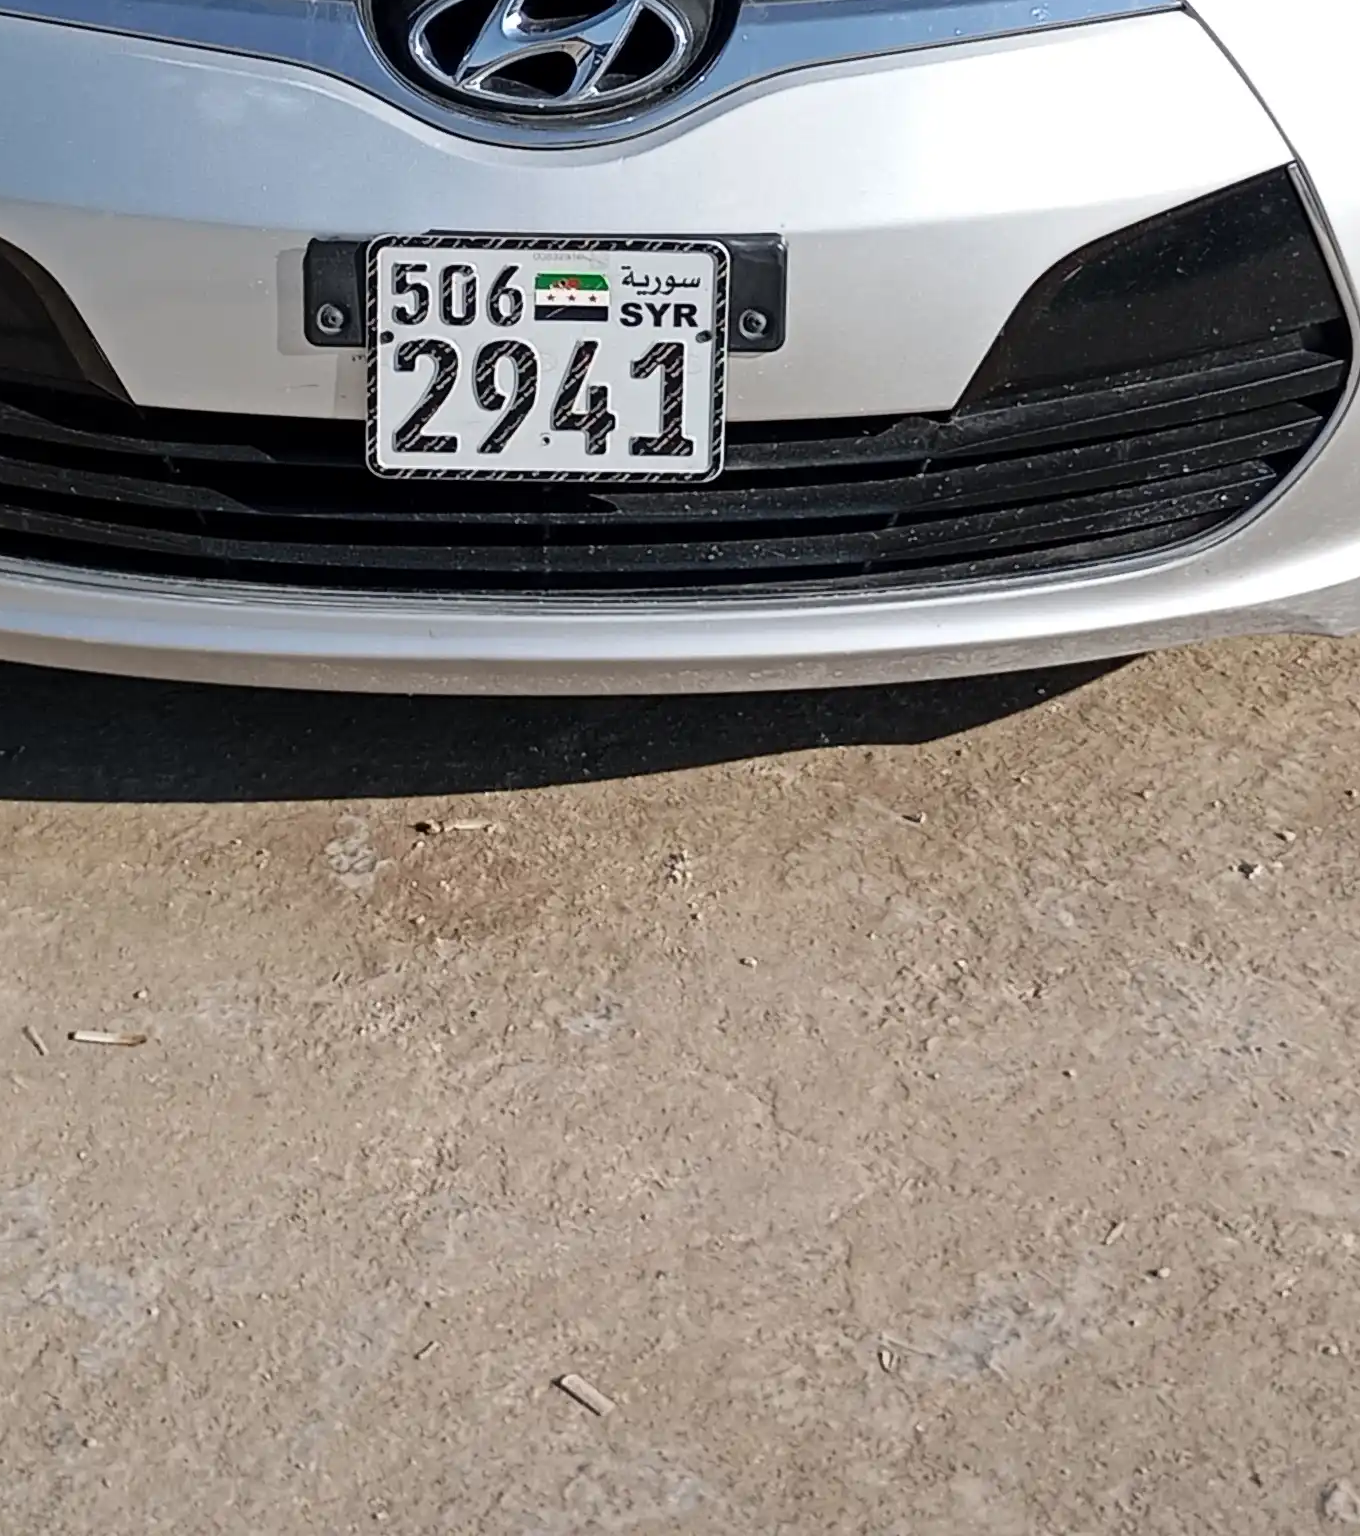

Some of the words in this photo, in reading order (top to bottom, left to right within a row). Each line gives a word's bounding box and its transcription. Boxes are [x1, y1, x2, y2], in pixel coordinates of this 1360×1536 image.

[392, 262, 525, 327] 506
[620, 265, 702, 296] سورية
[619, 302, 699, 328] SYR
[392, 338, 696, 457] 2941
